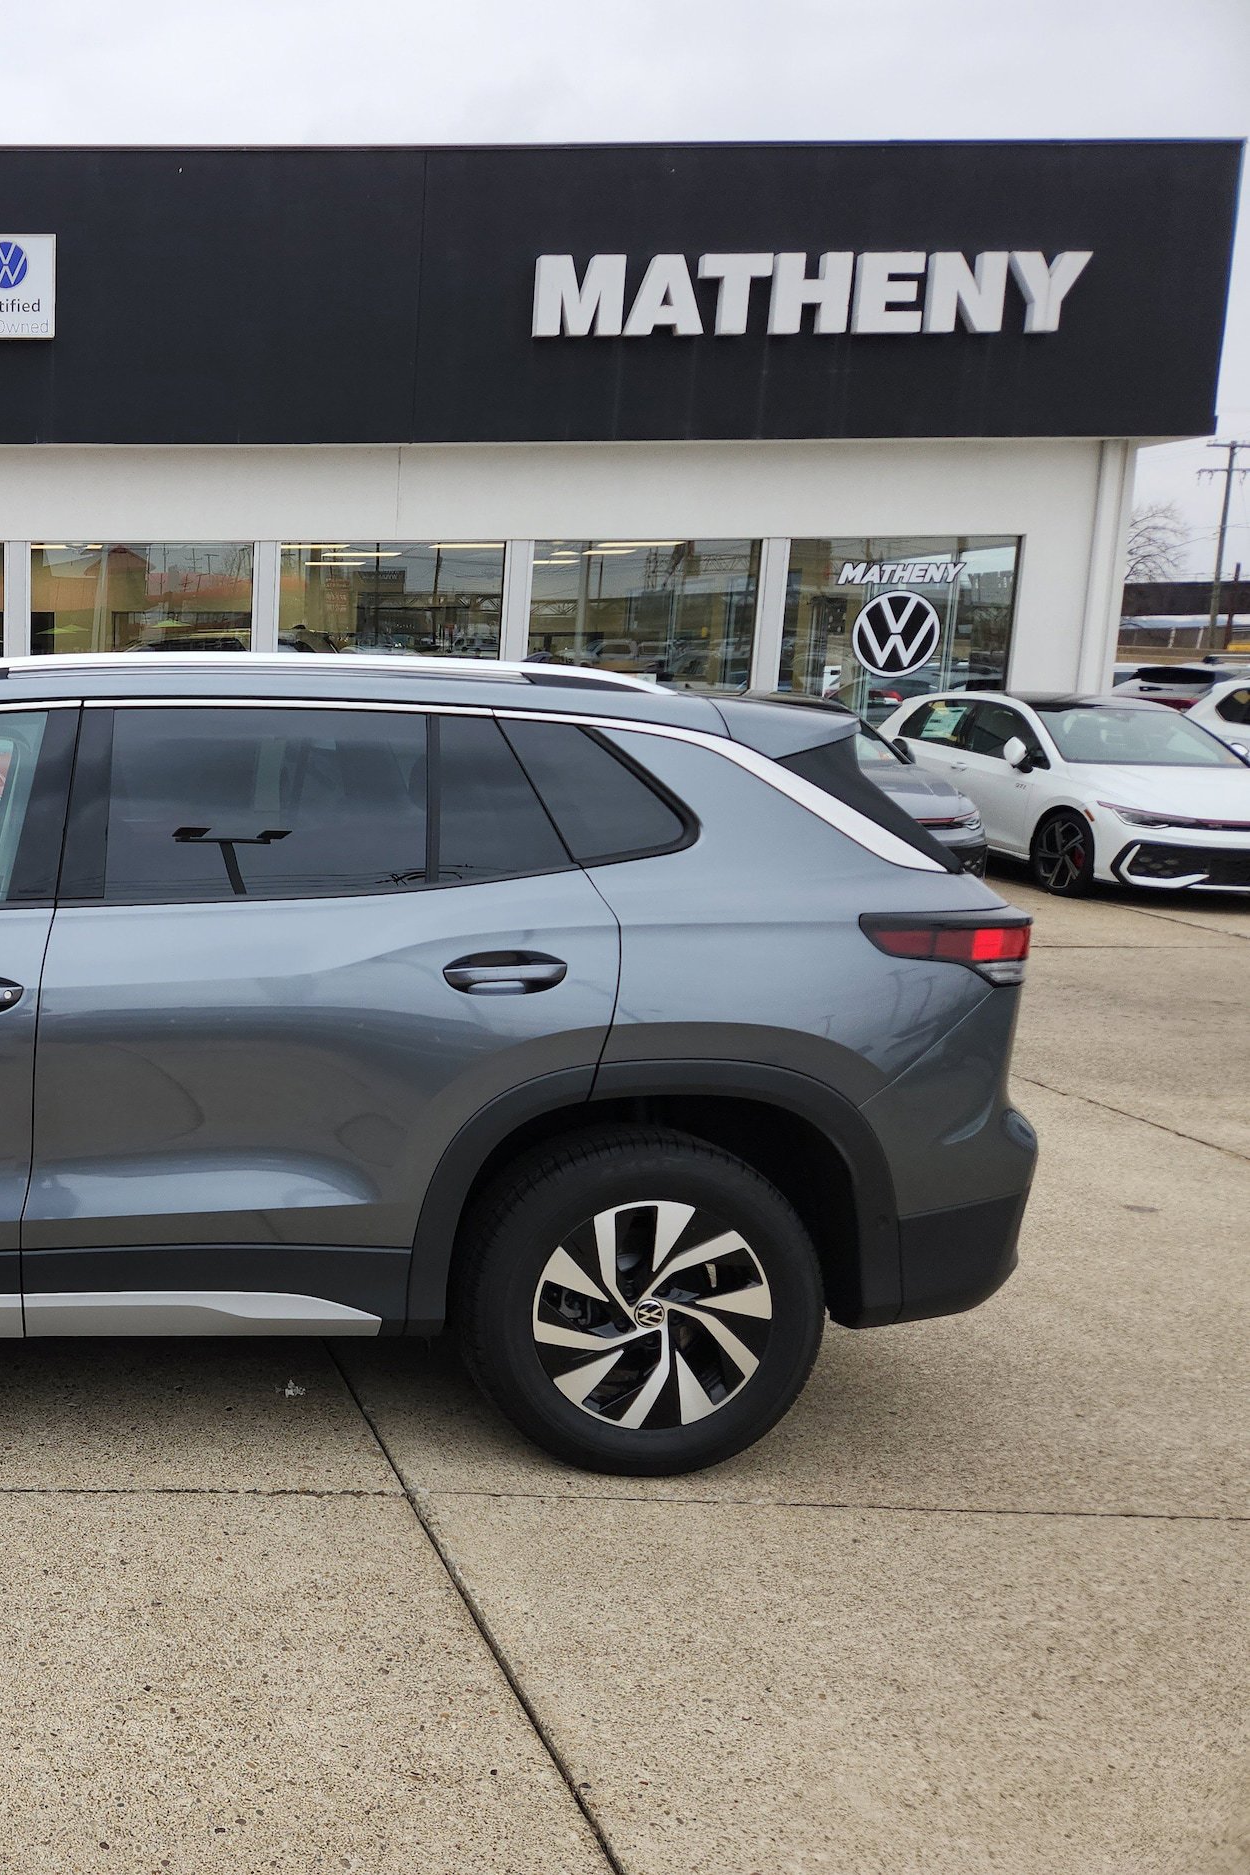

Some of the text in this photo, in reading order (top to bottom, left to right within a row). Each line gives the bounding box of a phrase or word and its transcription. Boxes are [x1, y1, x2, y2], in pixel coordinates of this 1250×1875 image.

[532, 251, 1093, 337] MATHENY
[836, 561, 967, 585] MATHENY
[852, 589, 941, 678] VW
